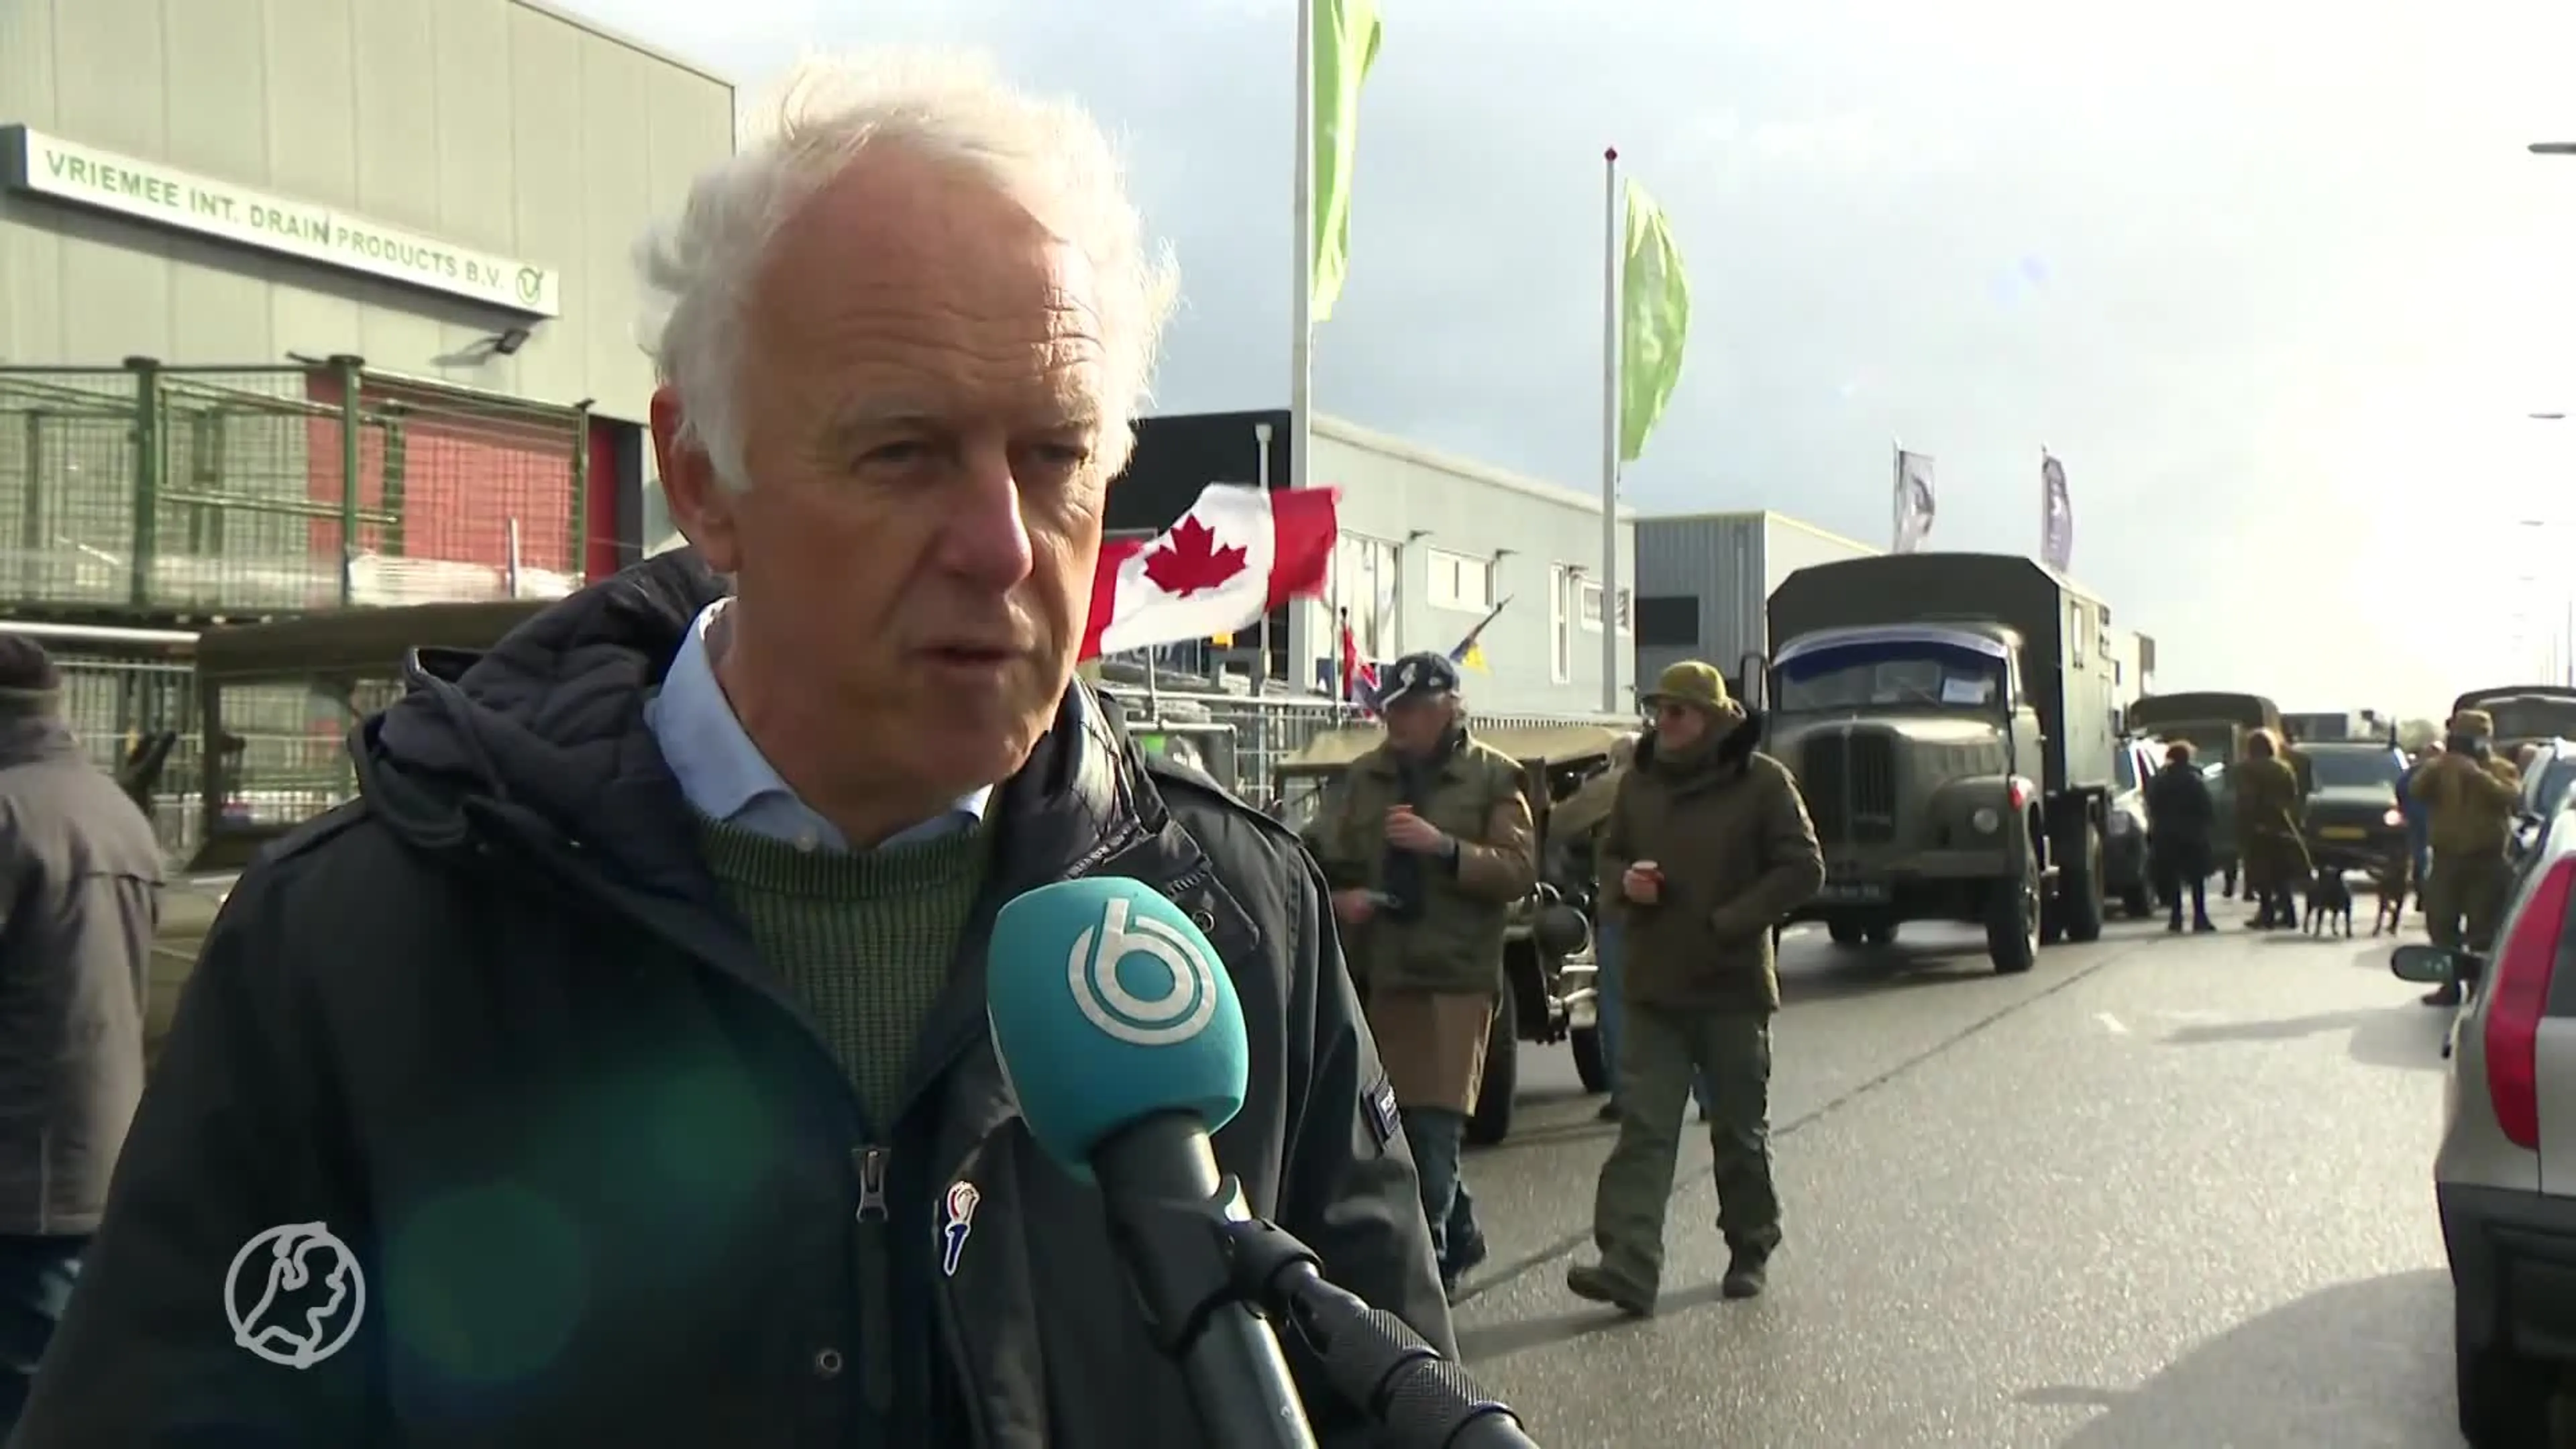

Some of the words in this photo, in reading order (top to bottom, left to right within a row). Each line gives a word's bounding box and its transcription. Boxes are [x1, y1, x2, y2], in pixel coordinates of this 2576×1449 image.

[46, 150, 179, 207] VRIEMEE
[189, 187, 239, 223] INT.
[250, 204, 330, 246] DRAIN
[337, 227, 458, 278] PRODUCTS
[466, 260, 504, 290] B.V.
